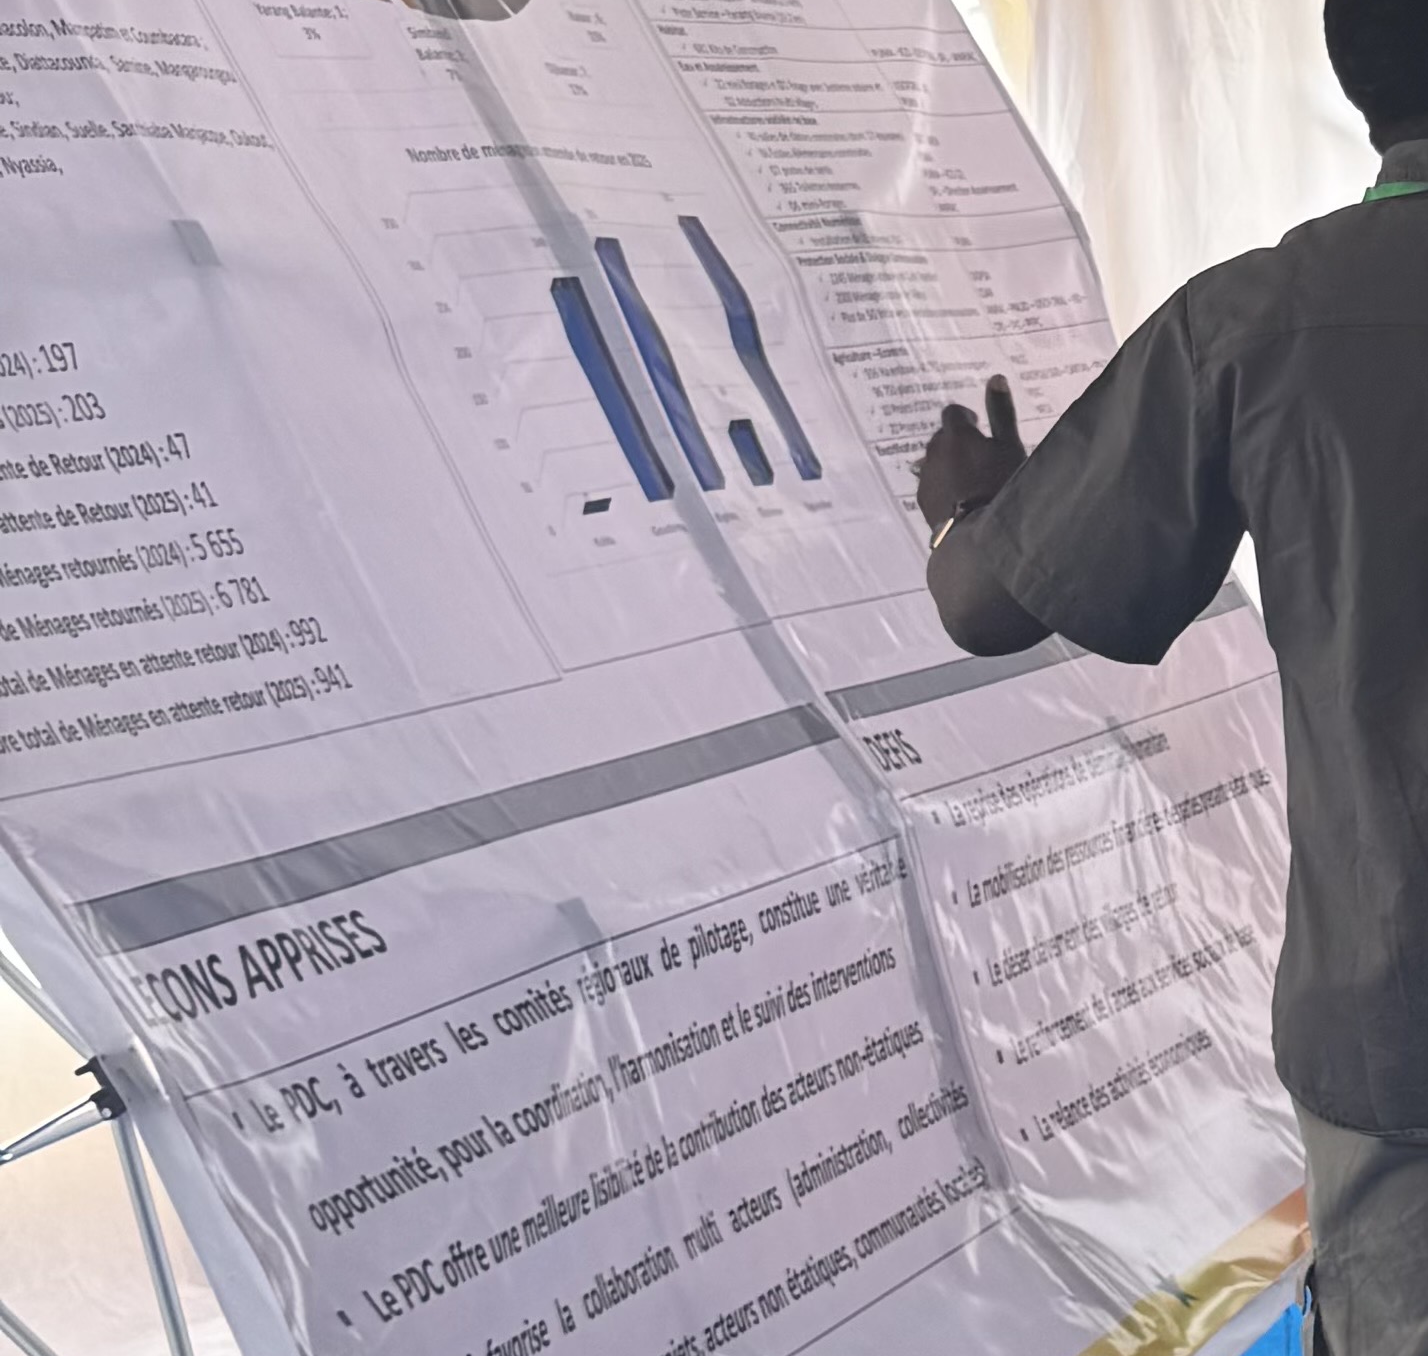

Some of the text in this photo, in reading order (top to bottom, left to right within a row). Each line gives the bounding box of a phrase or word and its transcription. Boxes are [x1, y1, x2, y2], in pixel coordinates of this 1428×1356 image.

[4, 154, 63, 177] Nyassia,
[40, 342, 79, 373] 197
[4, 392, 106, 432] (2025) 203
[53, 432, 191, 475] Retour (2024) 47
[77, 489, 187, 525] Retour (2025)
[61, 549, 138, 580] retournés
[18, 598, 164, 639] Ménages retournés
[48, 616, 328, 691] Ménages attente retour 992
[79, 662, 353, 738] Ménages attente retour 941
[238, 910, 388, 1000] APPRISES
[337, 879, 852, 1099] à travers les comités de pilotage, constitue une
[307, 947, 896, 1236] opportunité, pour la coordination, l'harmonisation et le suivi des interventions
[362, 1020, 924, 1323] Le PDC offre une meilleure de la contribution des acteurs non-étatiques
[554, 1298, 577, 1335] la
[582, 1245, 679, 1320] collaboration
[727, 1186, 784, 1234] acteurs
[786, 1128, 893, 1208] (administration,
[897, 1078, 969, 1141] collectivités
[704, 1298, 761, 1355] acteurs
[758, 1281, 790, 1319] non
[786, 1244, 859, 1302] étatiques,
[853, 1188, 946, 1259] communautés
